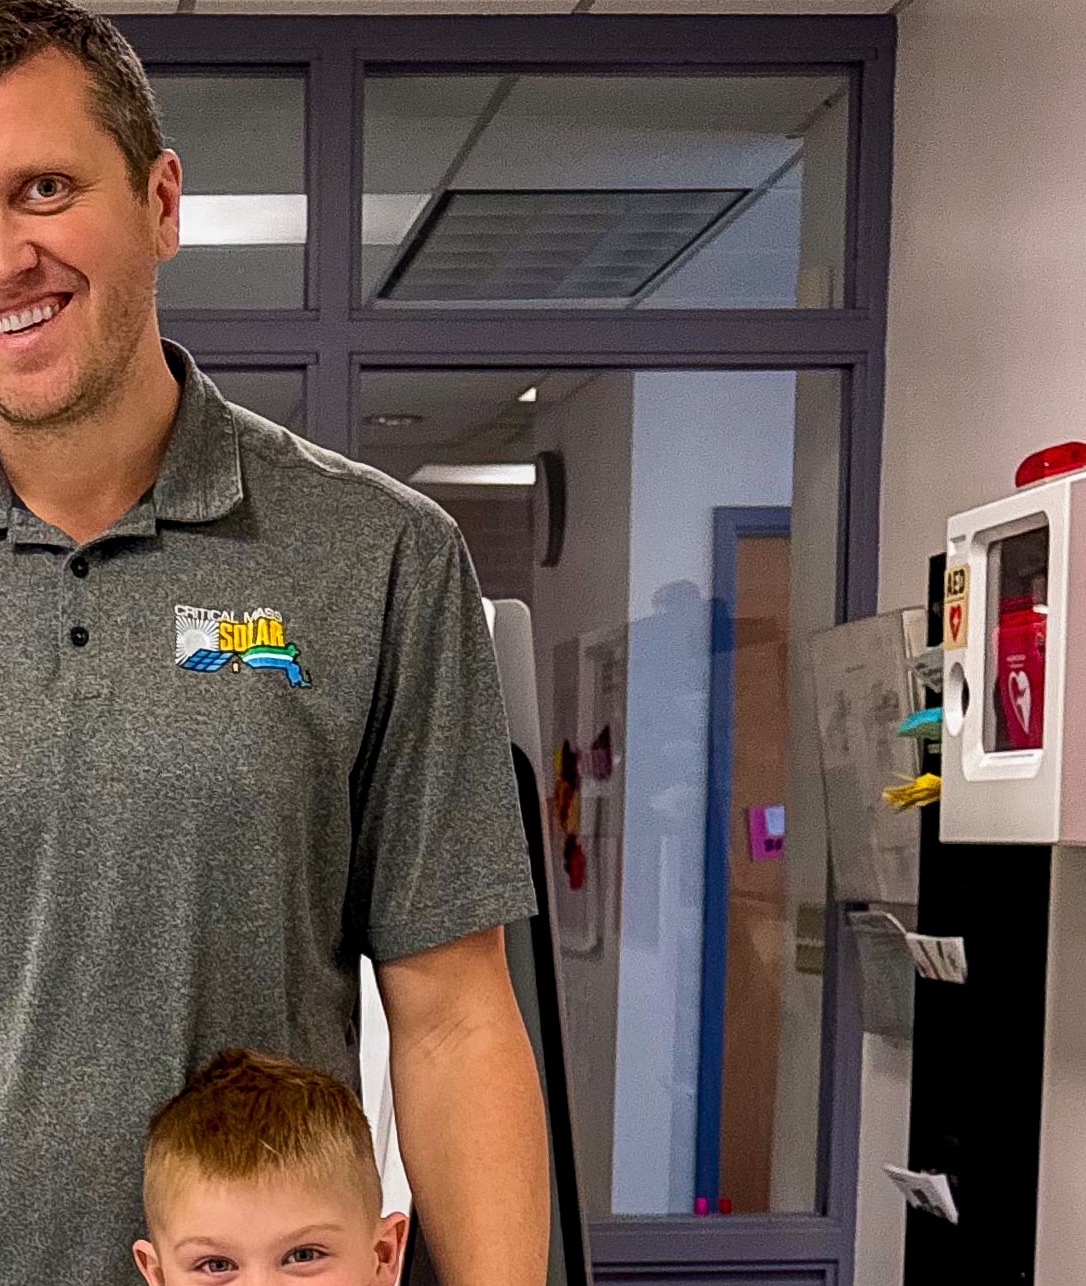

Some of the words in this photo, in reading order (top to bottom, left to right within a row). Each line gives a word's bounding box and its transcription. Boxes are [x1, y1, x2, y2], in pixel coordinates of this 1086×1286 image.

[948, 568, 965, 595] AED
[174, 604, 236, 622] CRITICAL
[244, 607, 283, 622] MASS
[219, 617, 285, 652] SOLAR
